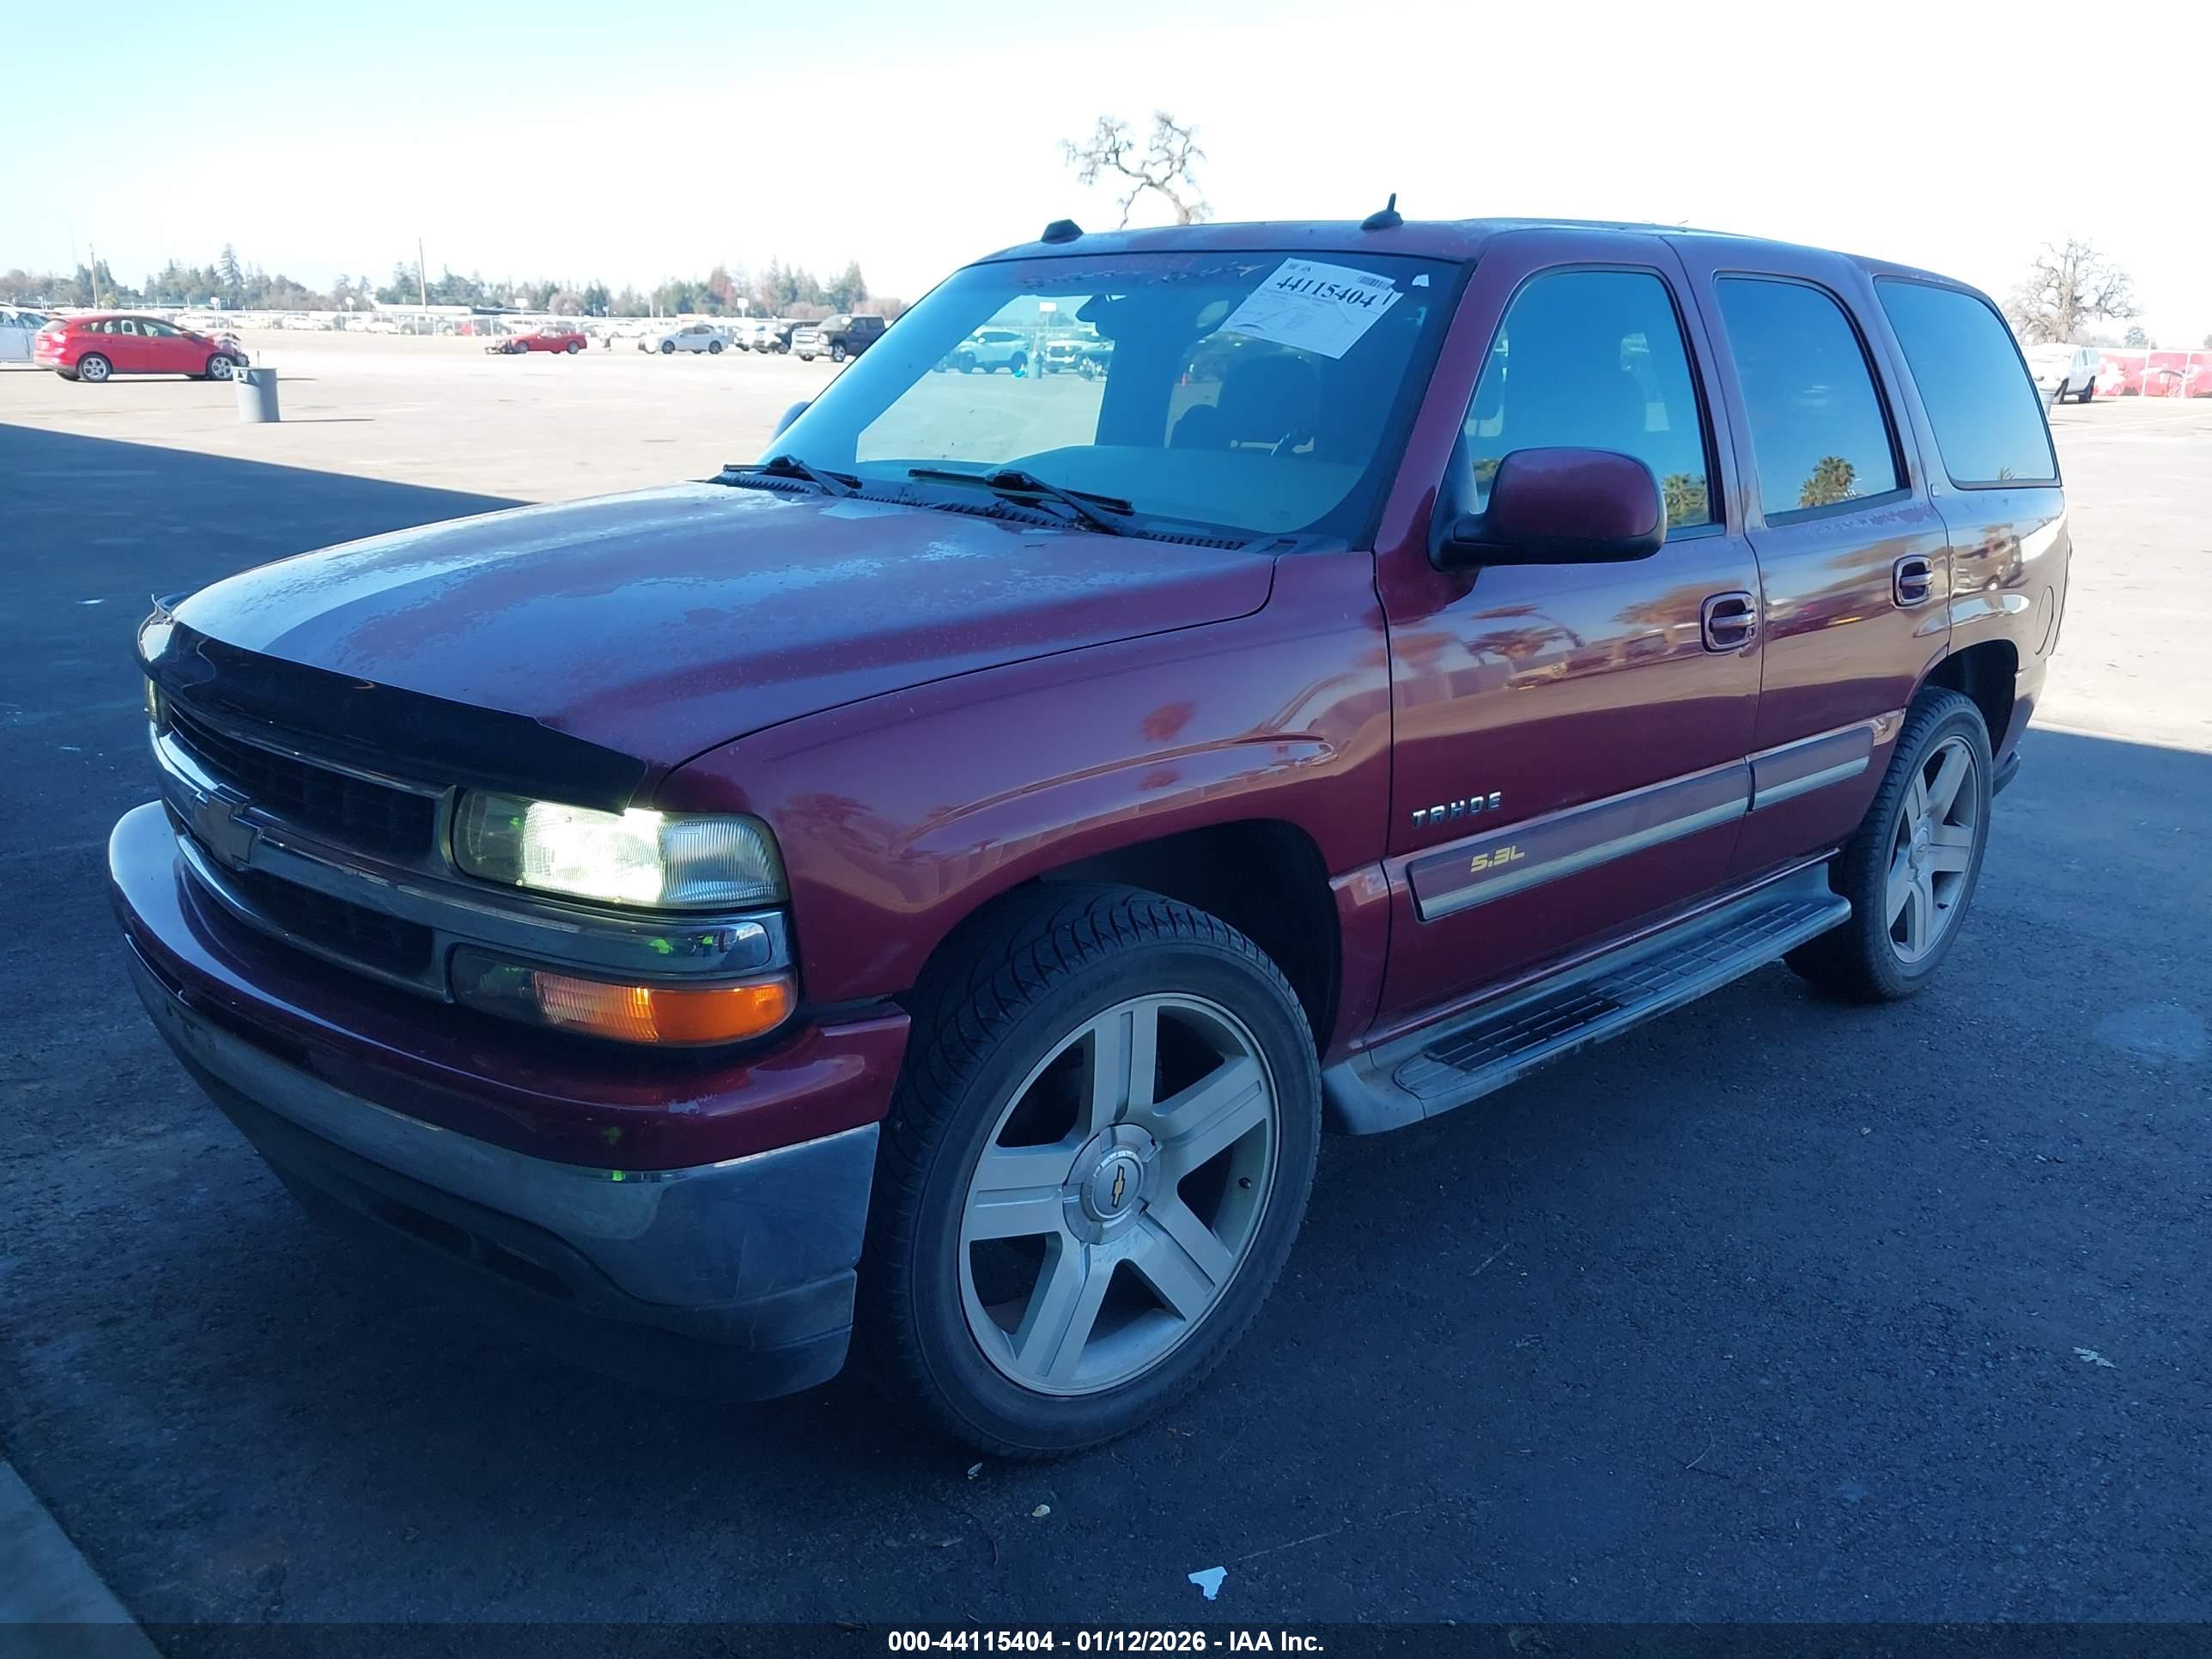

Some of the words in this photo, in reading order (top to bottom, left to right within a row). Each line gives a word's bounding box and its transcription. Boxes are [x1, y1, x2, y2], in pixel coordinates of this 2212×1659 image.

[1276, 276, 1377, 307] 44115404
[1411, 791, 1502, 829] TAHOE
[1470, 845, 1525, 872] 5.3L
